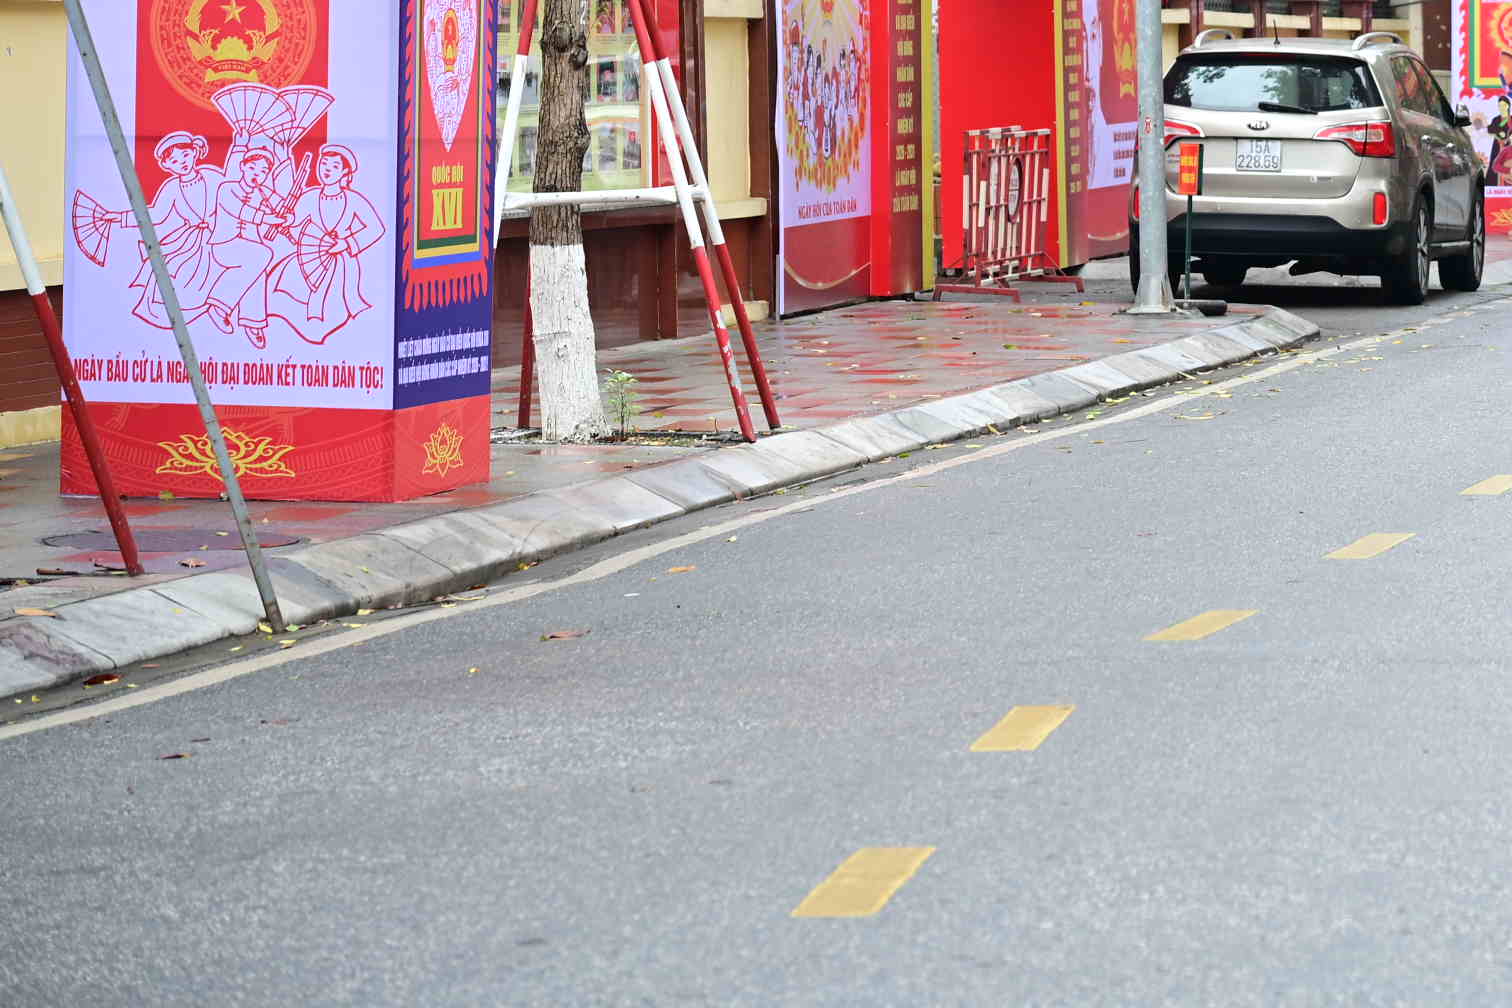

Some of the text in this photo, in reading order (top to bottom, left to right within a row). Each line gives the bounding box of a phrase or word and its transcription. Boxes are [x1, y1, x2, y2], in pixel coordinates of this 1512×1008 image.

[1250, 139, 1270, 154] 15A
[431, 188, 464, 230] XVI
[74, 354, 104, 382] NGÀY
[107, 351, 129, 382] BẦU
[132, 350, 149, 382] CỬ
[150, 354, 163, 383] LÀ
[200, 356, 218, 390] HỘI
[222, 361, 240, 390] ĐẠI
[244, 358, 273, 386] ĐOÀN
[277, 354, 297, 387] KẾT
[300, 359, 329, 388] TOÀN
[333, 359, 355, 389] DÂN
[359, 360, 384, 394] TỘC!
